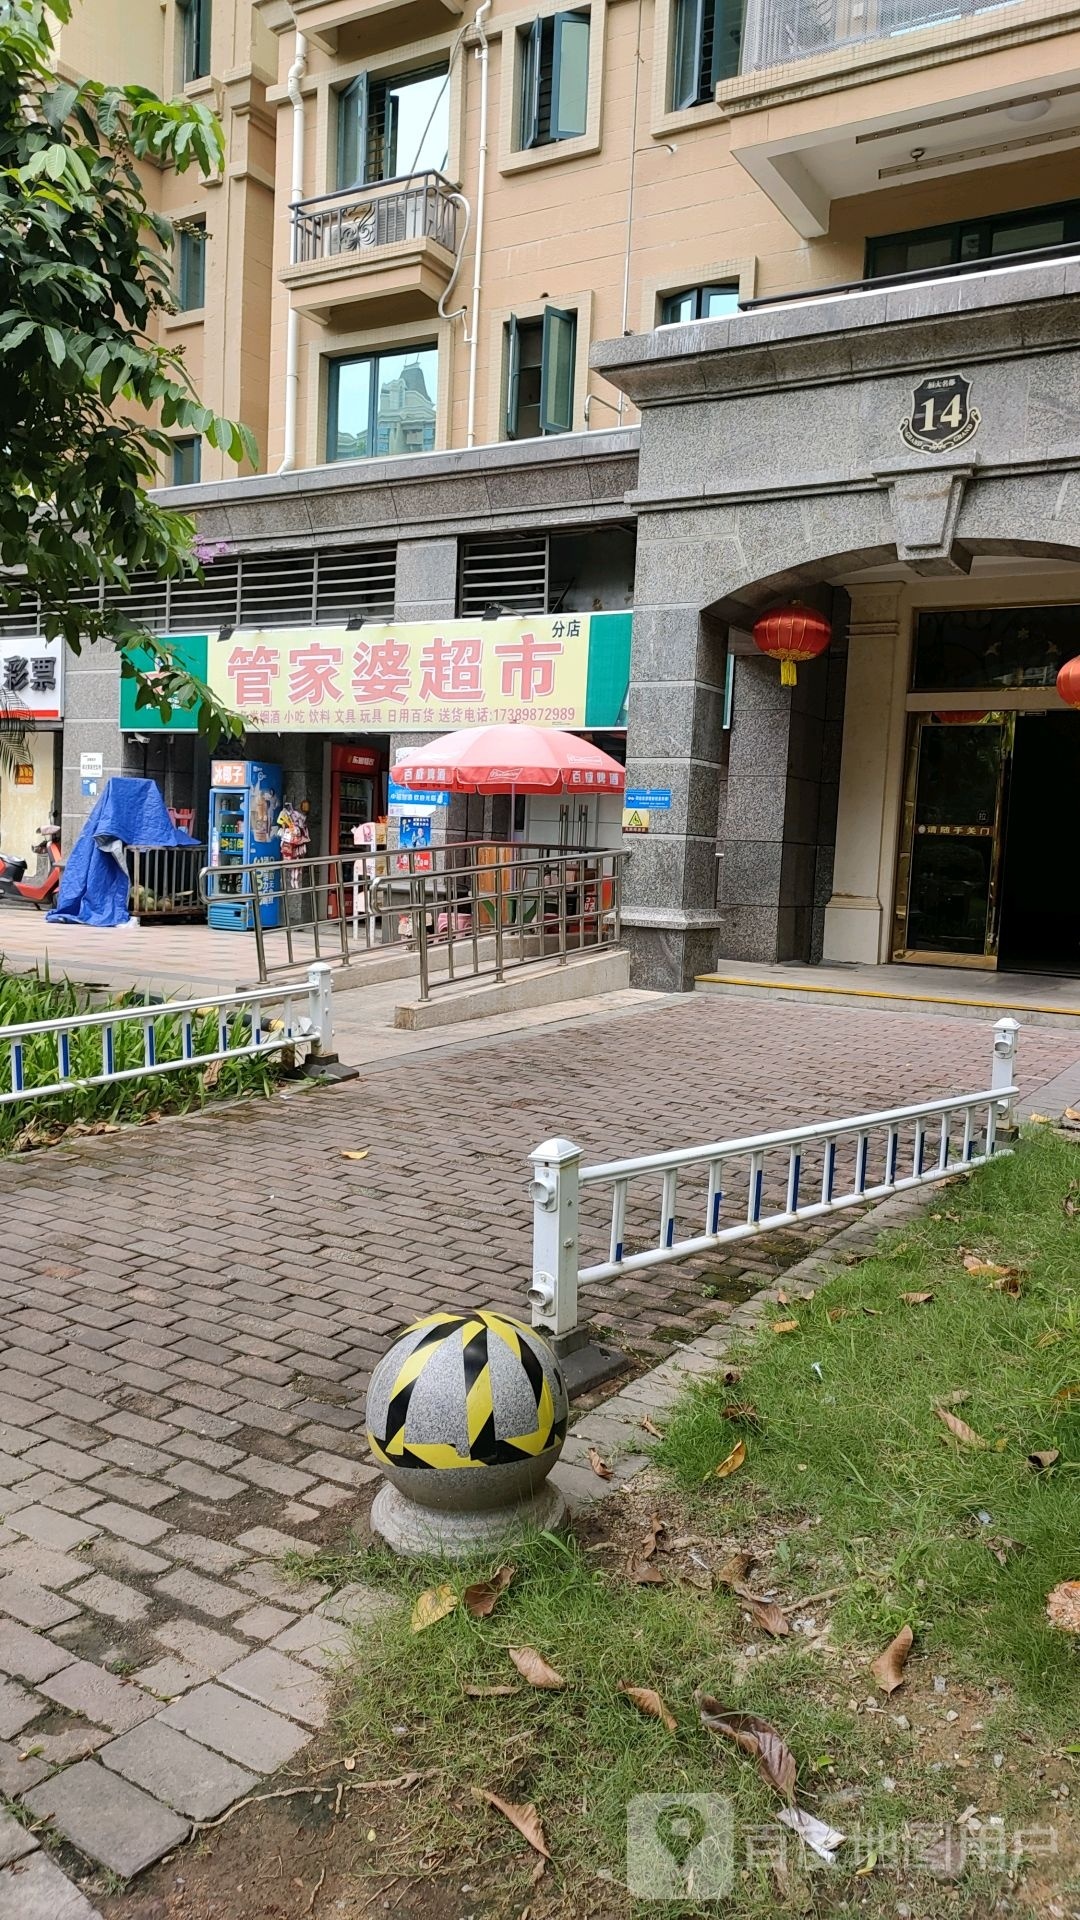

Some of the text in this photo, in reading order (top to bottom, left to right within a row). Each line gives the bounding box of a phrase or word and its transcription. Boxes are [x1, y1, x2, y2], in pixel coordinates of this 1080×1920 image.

[919, 394, 963, 432] 14
[953, 423, 973, 442] GRAND
[551, 619, 582, 638] 分店
[3, 655, 57, 692] 彩票
[227, 633, 564, 707] 管家婆超市
[284, 709, 305, 724] 小吃
[309, 708, 331, 724] 饮料
[335, 708, 357, 724] 文具
[360, 708, 382, 724] 玩具
[387, 708, 435, 723] 日用百货
[213, 764, 243, 785] 冰椰子
[927, 825, 990, 836] 请随手关门
